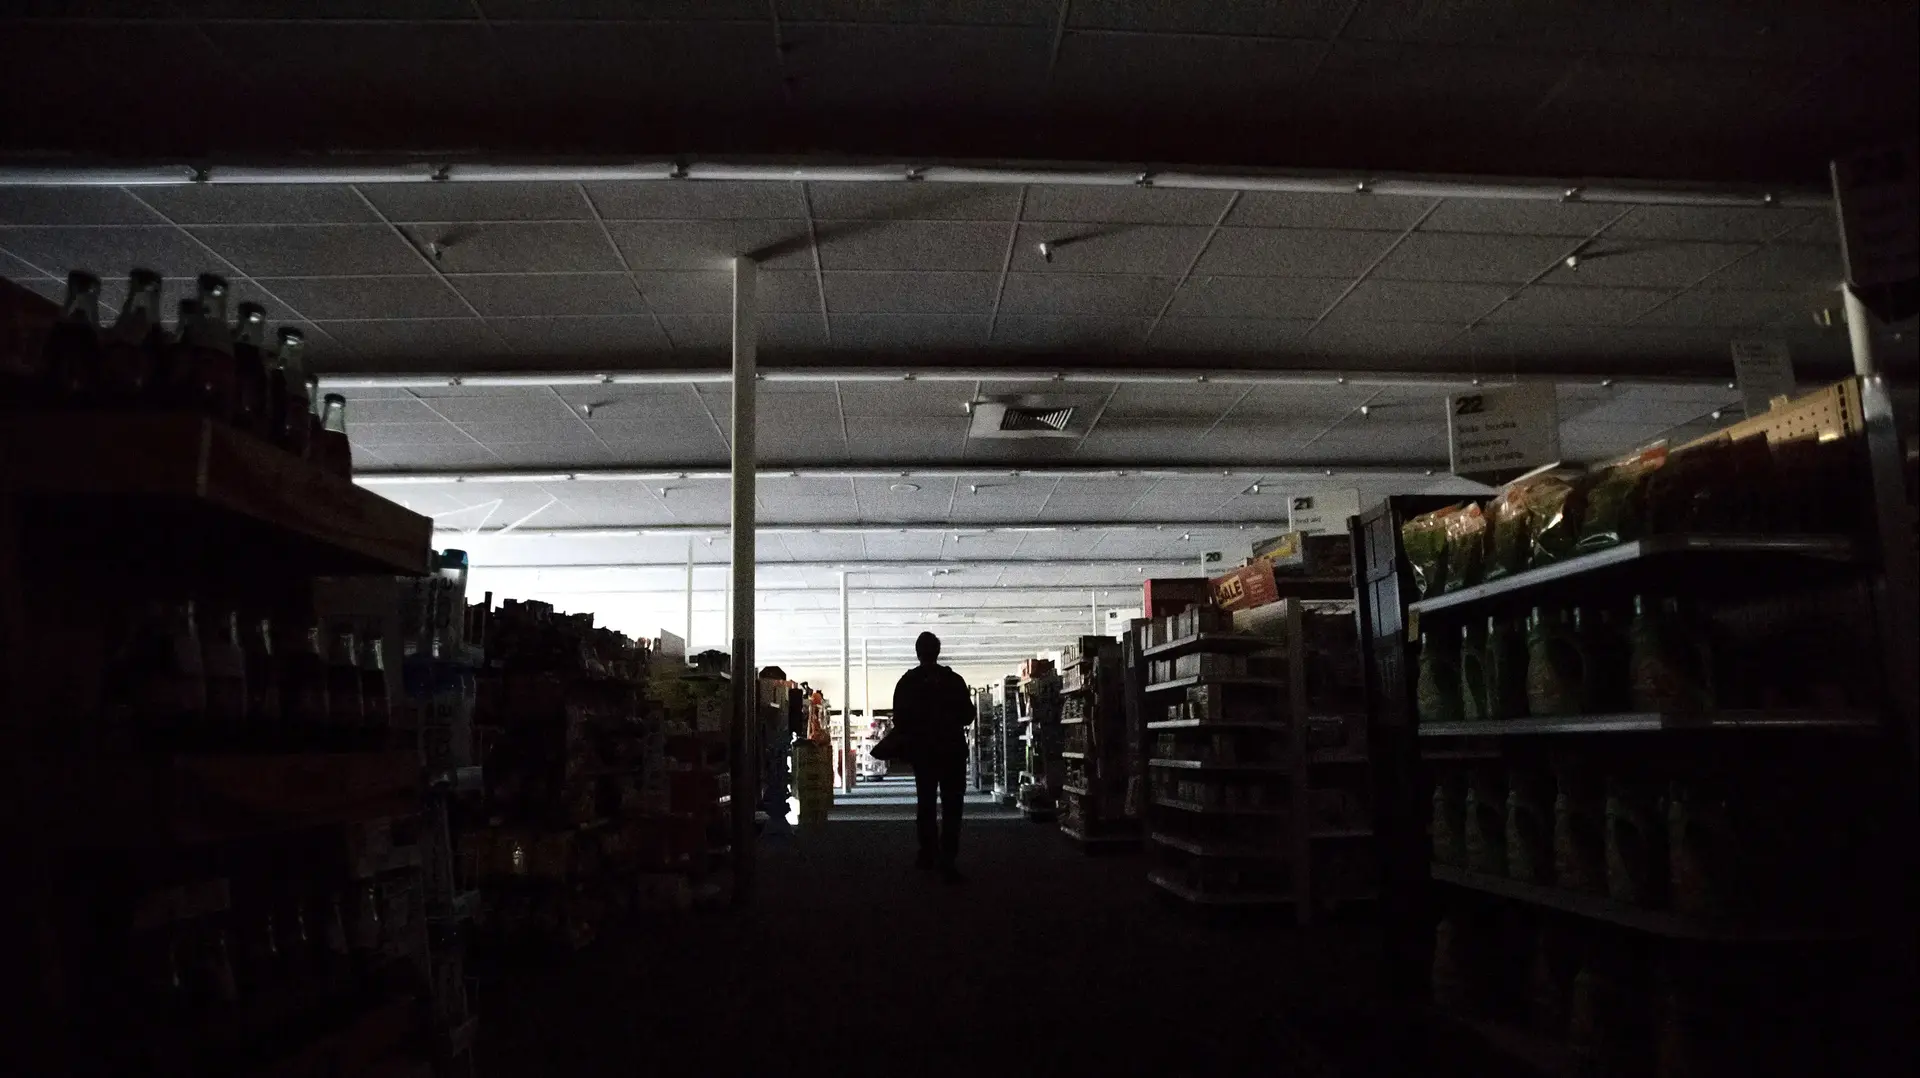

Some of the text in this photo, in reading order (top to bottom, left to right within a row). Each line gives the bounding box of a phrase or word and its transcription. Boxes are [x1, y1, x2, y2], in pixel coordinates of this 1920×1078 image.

[1455, 394, 1484, 415] 22
[1294, 496, 1314, 511] 21
[1206, 552, 1222, 563] 20
[1214, 579, 1243, 605] SALE
